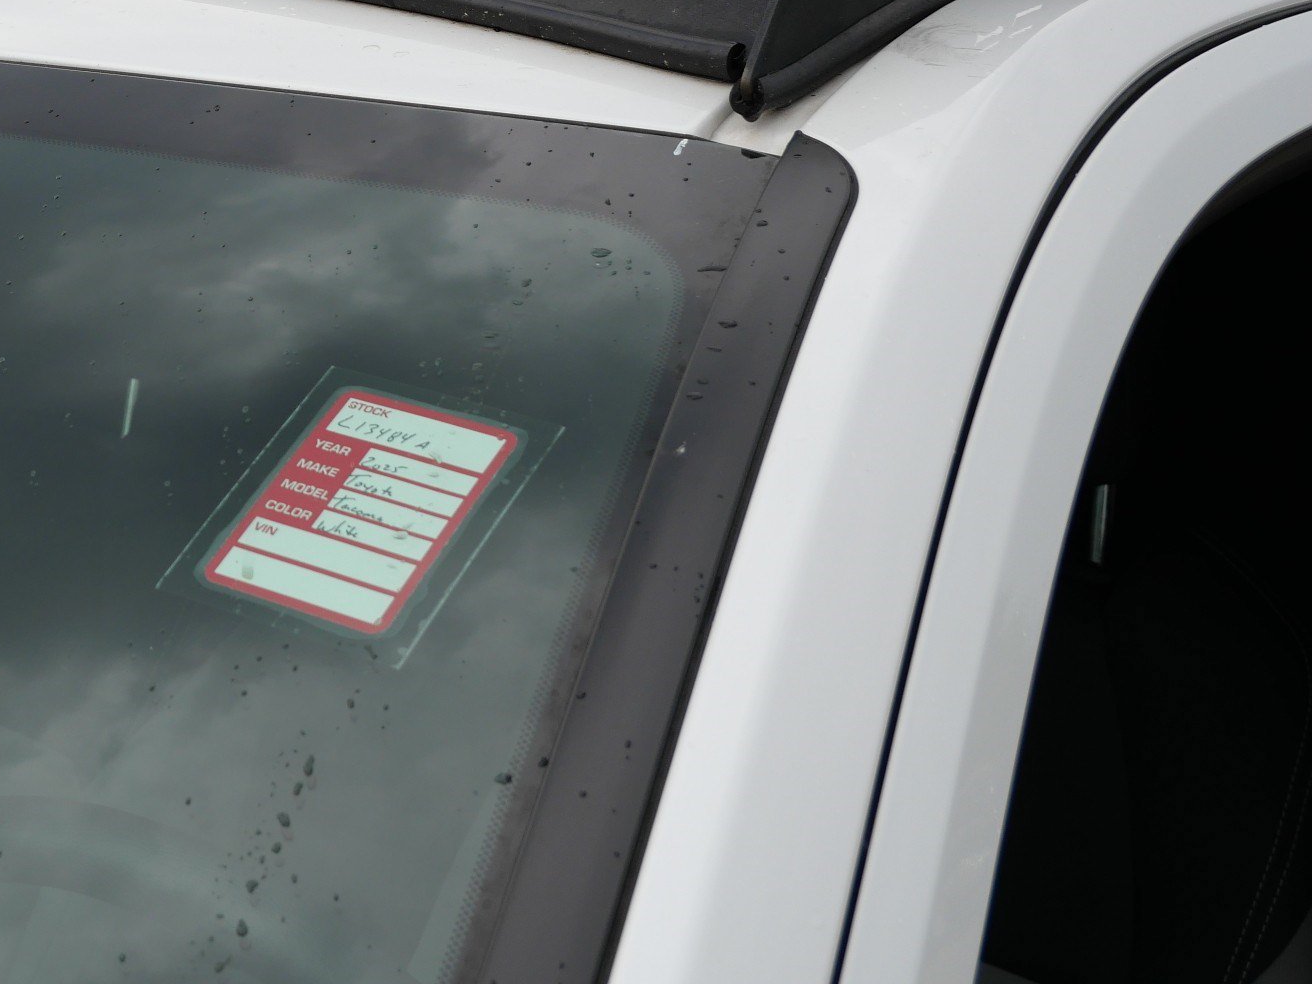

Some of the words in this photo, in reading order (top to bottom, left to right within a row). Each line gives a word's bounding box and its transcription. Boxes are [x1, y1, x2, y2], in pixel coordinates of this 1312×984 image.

[348, 401, 392, 418] STOCK
[314, 438, 352, 456] YEAR
[296, 458, 340, 477] MAKE
[280, 478, 328, 501] MODEL
[265, 499, 313, 521] COLOR
[253, 522, 278, 536] VIN
